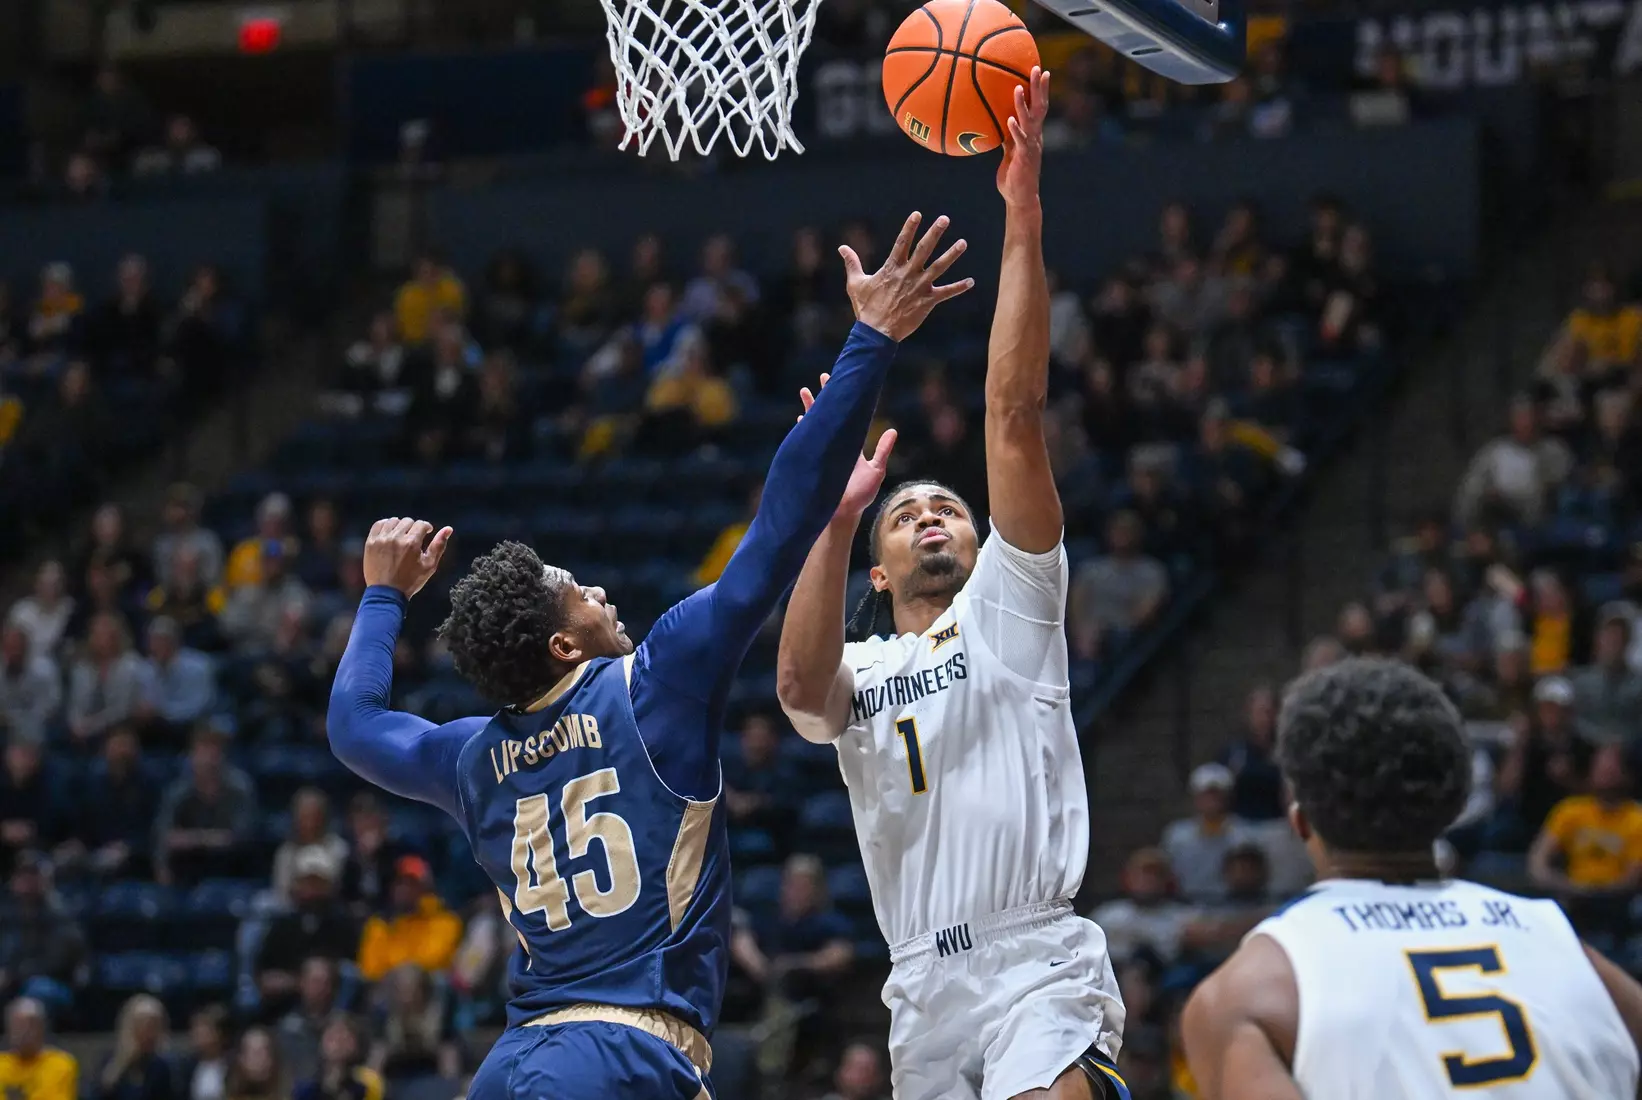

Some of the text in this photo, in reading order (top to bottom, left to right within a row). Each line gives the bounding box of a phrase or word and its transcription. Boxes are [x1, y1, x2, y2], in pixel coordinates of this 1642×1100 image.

[491, 713, 602, 784] LIPSCOMB
[895, 716, 928, 796] 1
[511, 767, 641, 932] 45
[935, 922, 973, 957] WVU
[1333, 900, 1468, 932] THOMAS
[1402, 943, 1539, 1091] 5
